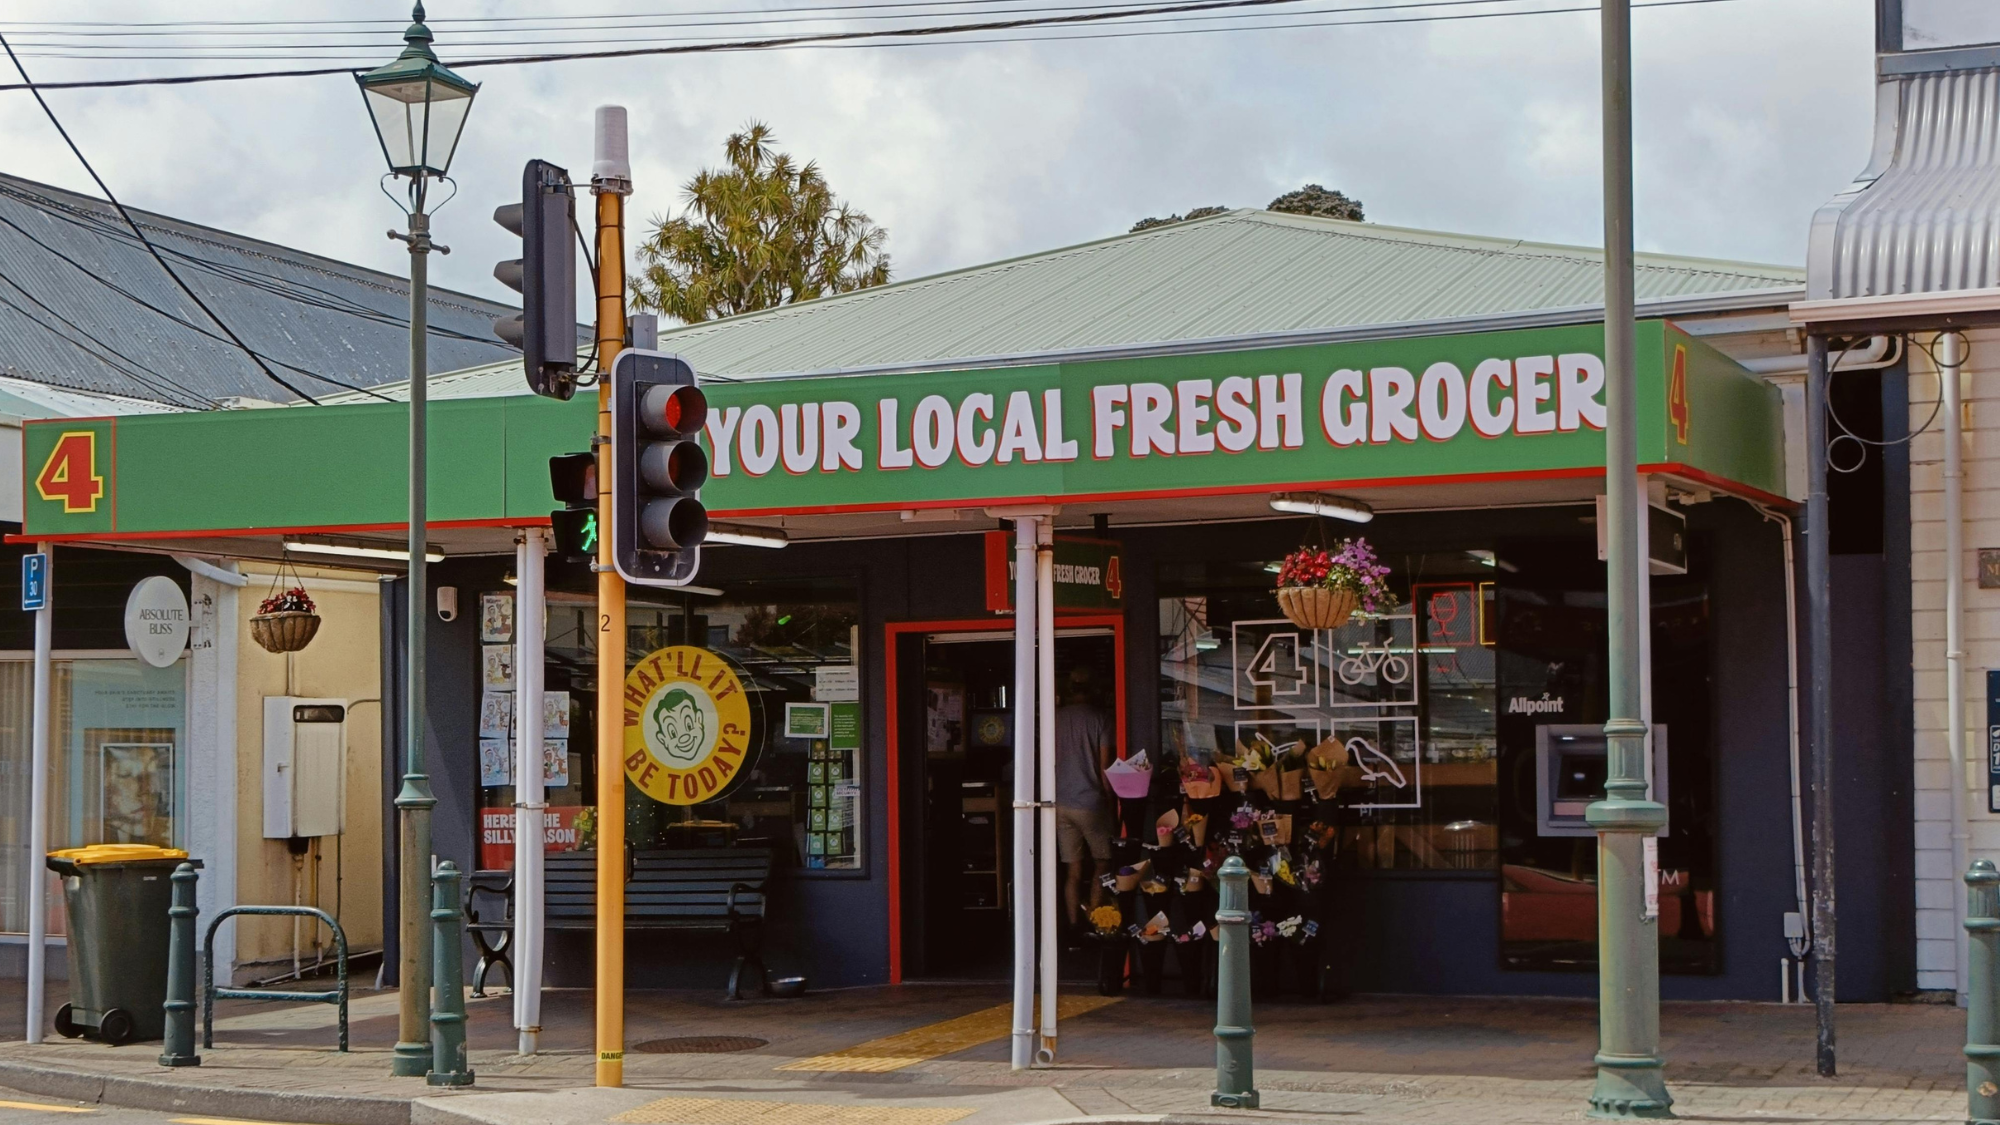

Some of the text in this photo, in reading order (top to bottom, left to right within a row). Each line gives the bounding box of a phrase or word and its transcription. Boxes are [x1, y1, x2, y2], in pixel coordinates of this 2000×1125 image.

[1669, 344, 1689, 445] 4
[703, 352, 1608, 478] YOUR LOCAL FRESH GROCER
[34, 431, 104, 514] 4
[30, 558, 39, 578] P
[1053, 563, 1074, 584] FRESH
[1074, 565, 1101, 586] GROCER
[1105, 555, 1122, 599] 4
[29, 580, 38, 597] 30
[139, 608, 184, 622] ABSOLUTE
[600, 614, 611, 633] 2
[149, 623, 173, 636] BLISS
[1244, 632, 1307, 696] 4
[624, 651, 739, 727] WHAT'LL IT
[1508, 692, 1564, 717] Allpoint
[624, 722, 746, 800] BE TODAY?
[483, 813, 560, 829] HERE HE
[601, 1052, 624, 1060] DANGE
